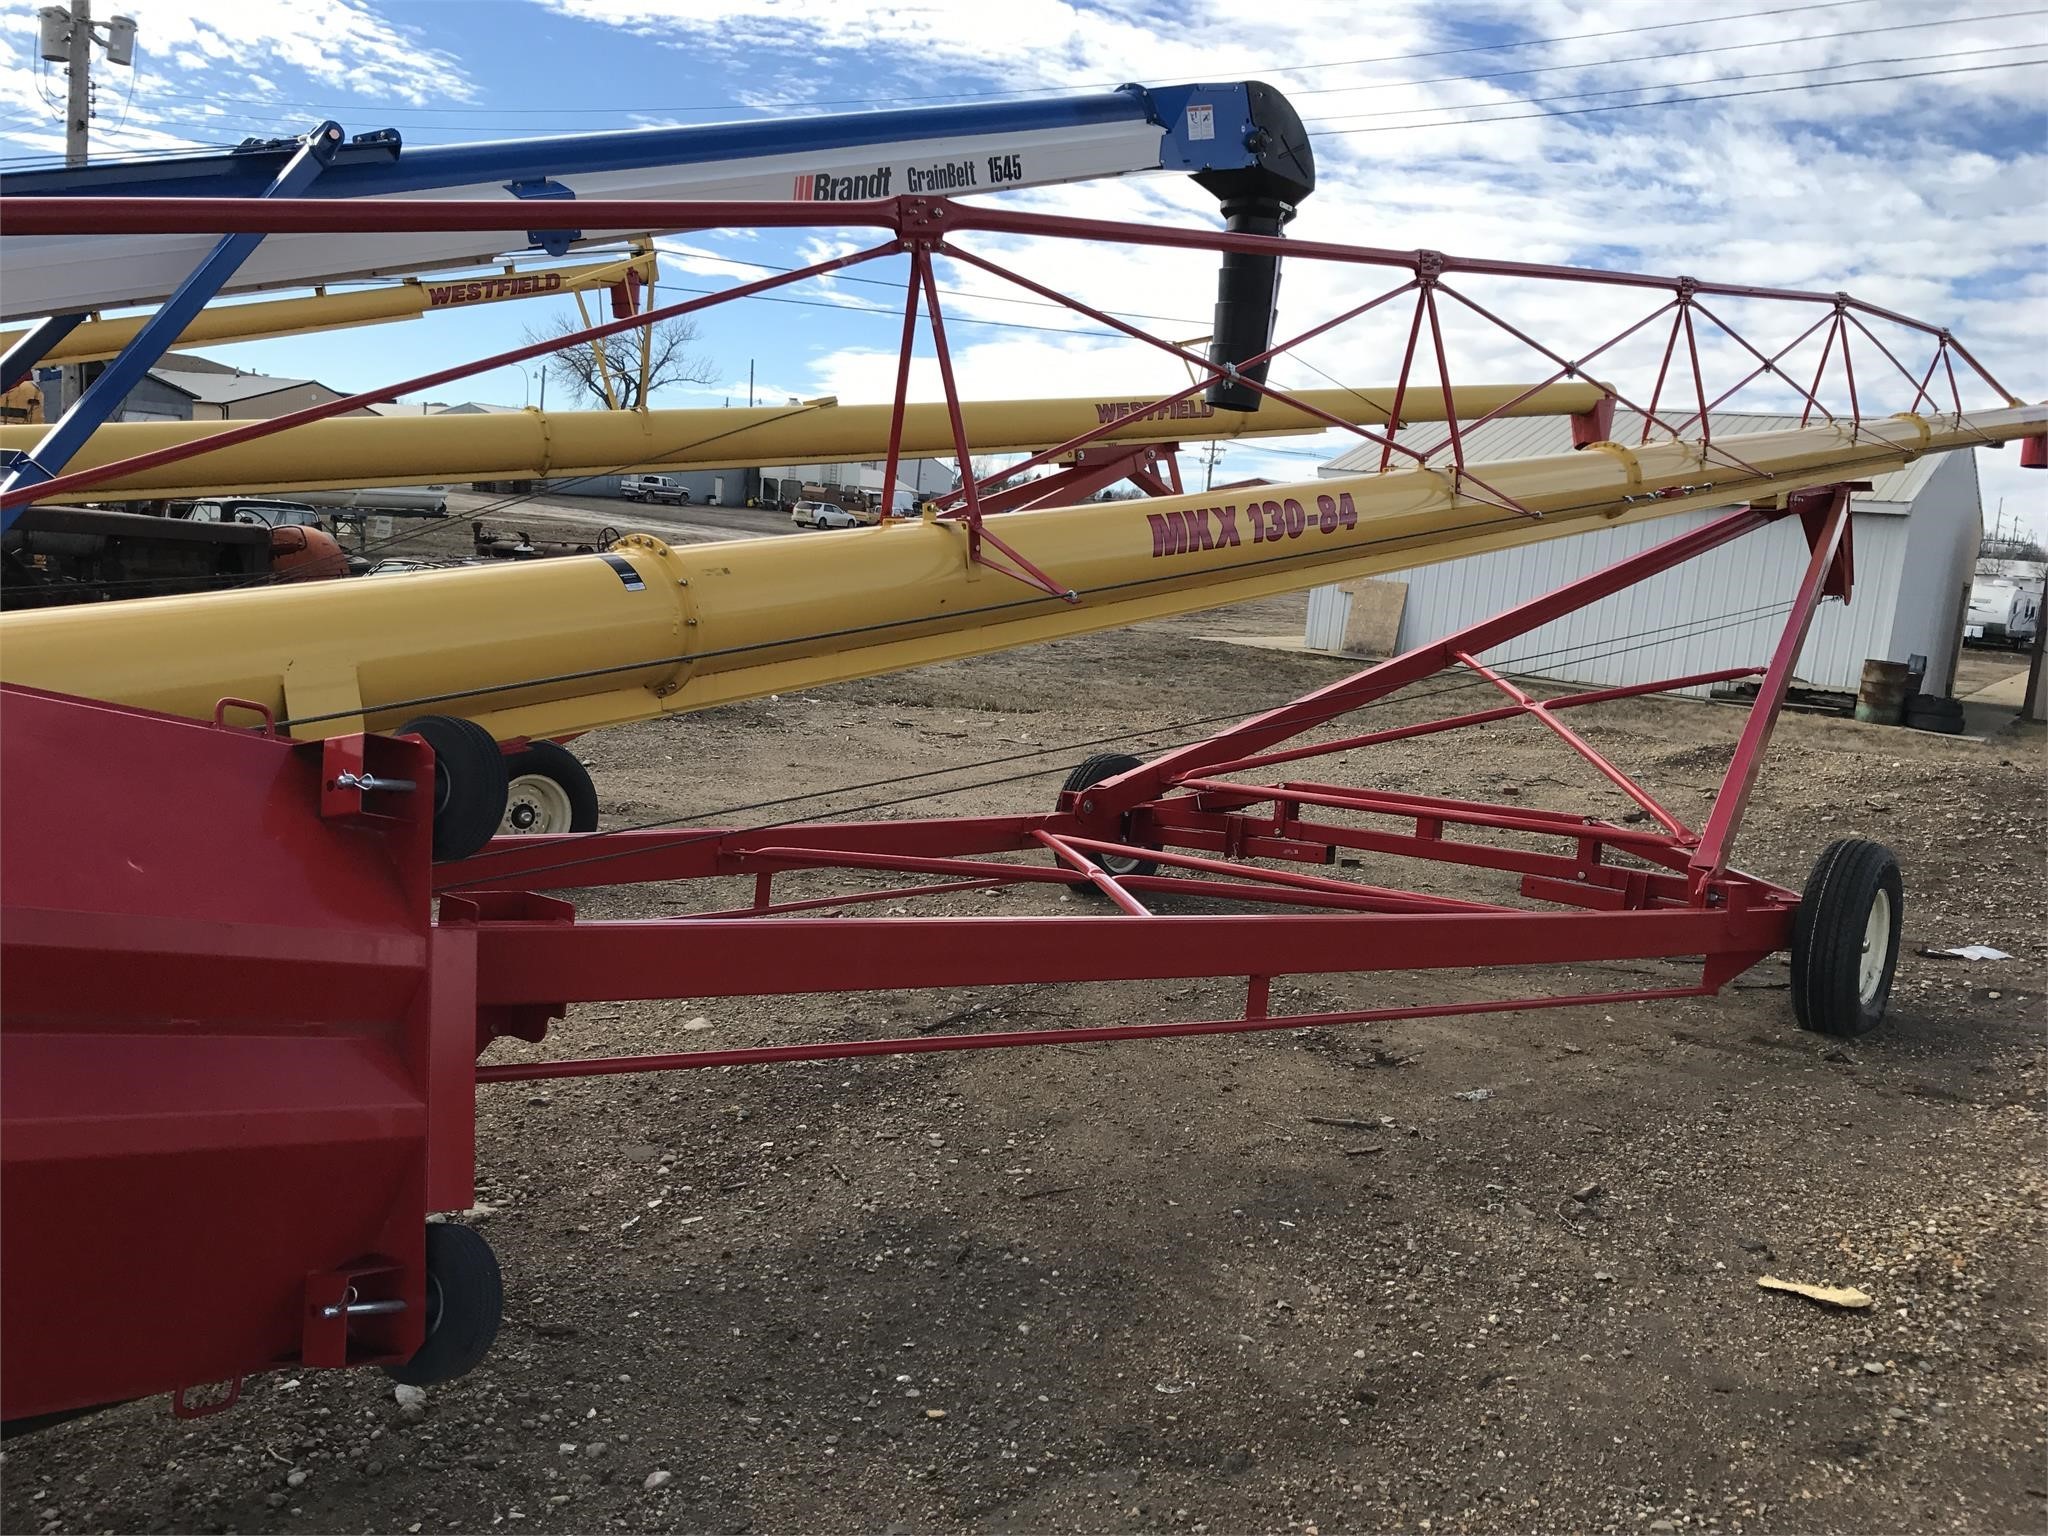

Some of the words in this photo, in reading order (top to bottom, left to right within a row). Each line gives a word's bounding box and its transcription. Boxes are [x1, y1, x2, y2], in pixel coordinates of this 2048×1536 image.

[814, 167, 892, 201] Brandt
[907, 161, 977, 193] GrainBelt
[988, 153, 1022, 183] 1545
[428, 273, 561, 306] WESTFIELD
[1146, 505, 1241, 558] MKX
[1246, 492, 1358, 544] 130-84
